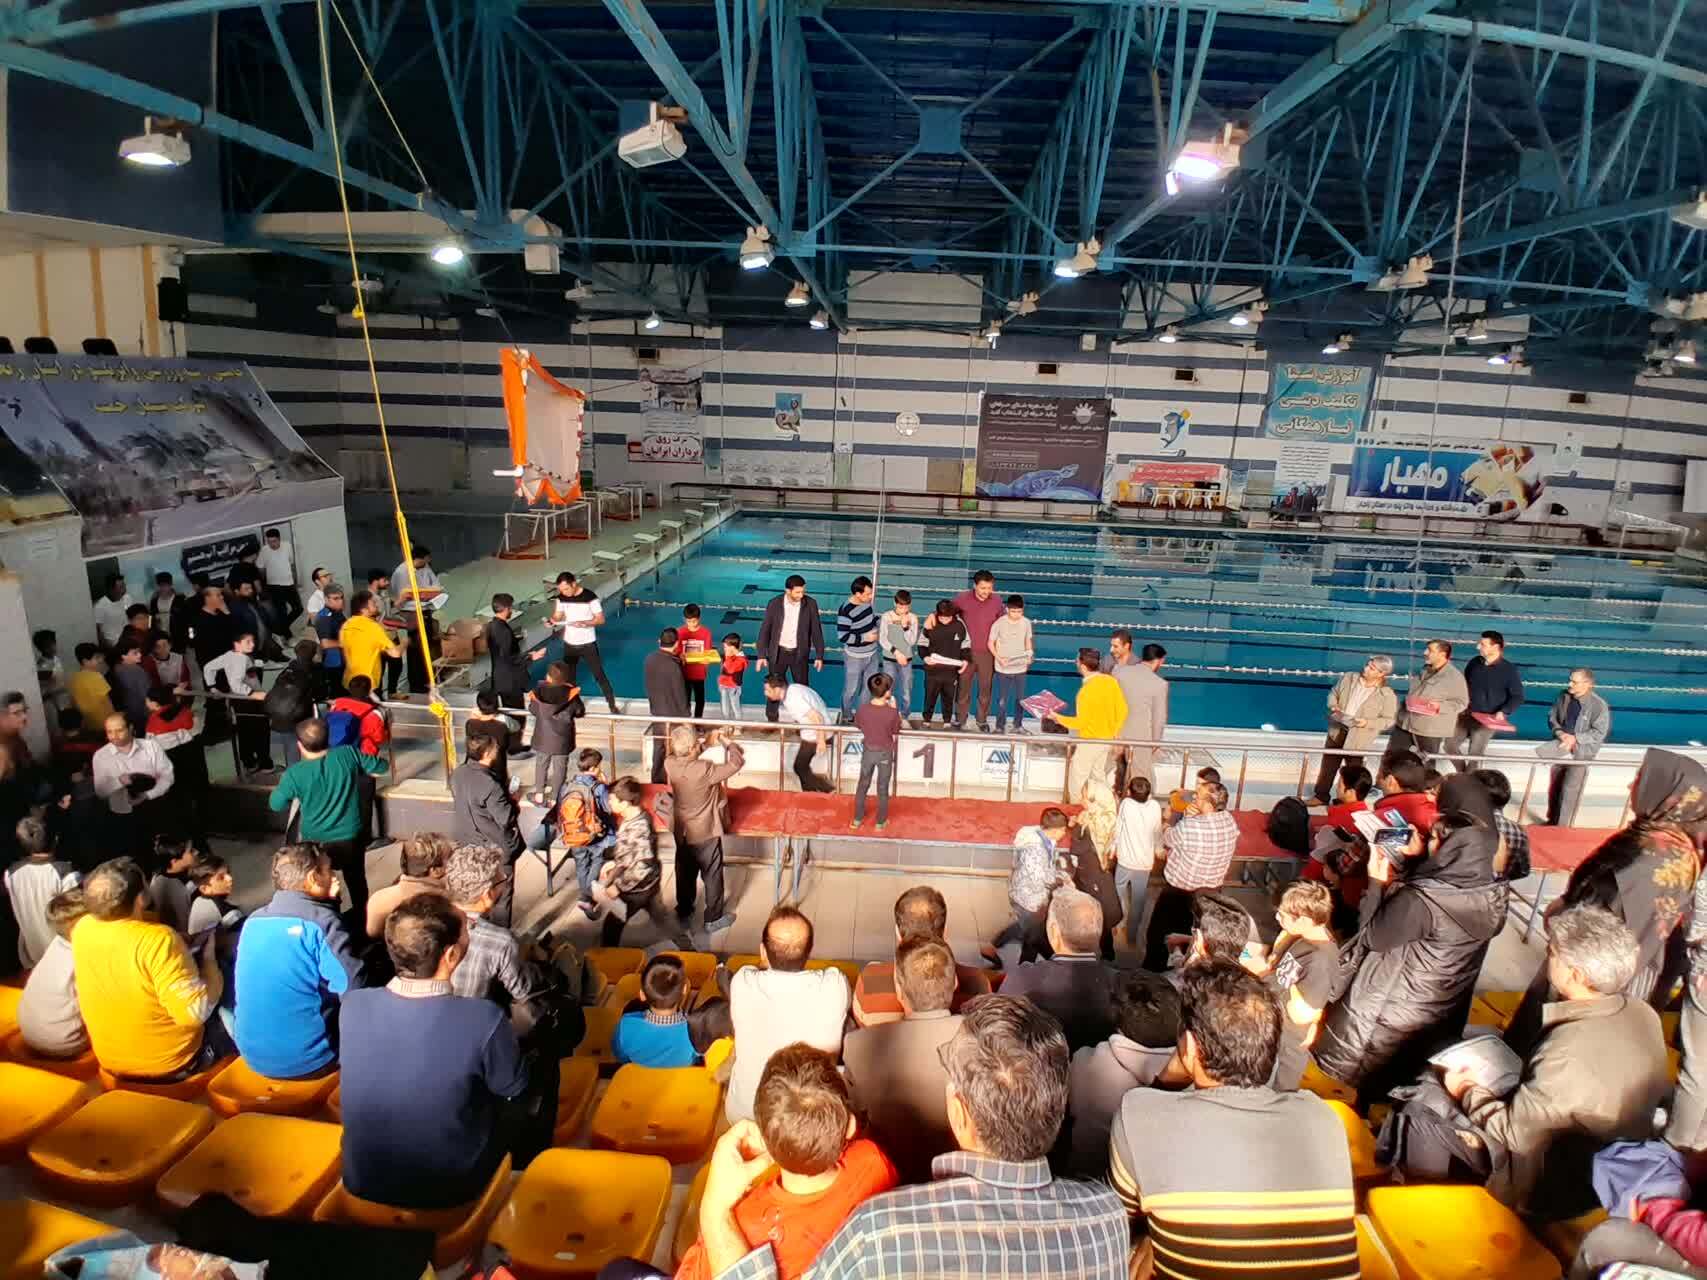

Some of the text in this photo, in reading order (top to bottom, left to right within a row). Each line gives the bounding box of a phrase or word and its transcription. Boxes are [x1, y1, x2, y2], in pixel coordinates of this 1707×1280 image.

[1322, 393, 1358, 408] تکلیف
[1380, 456, 1448, 493] مهیار
[913, 743, 935, 778] 1
